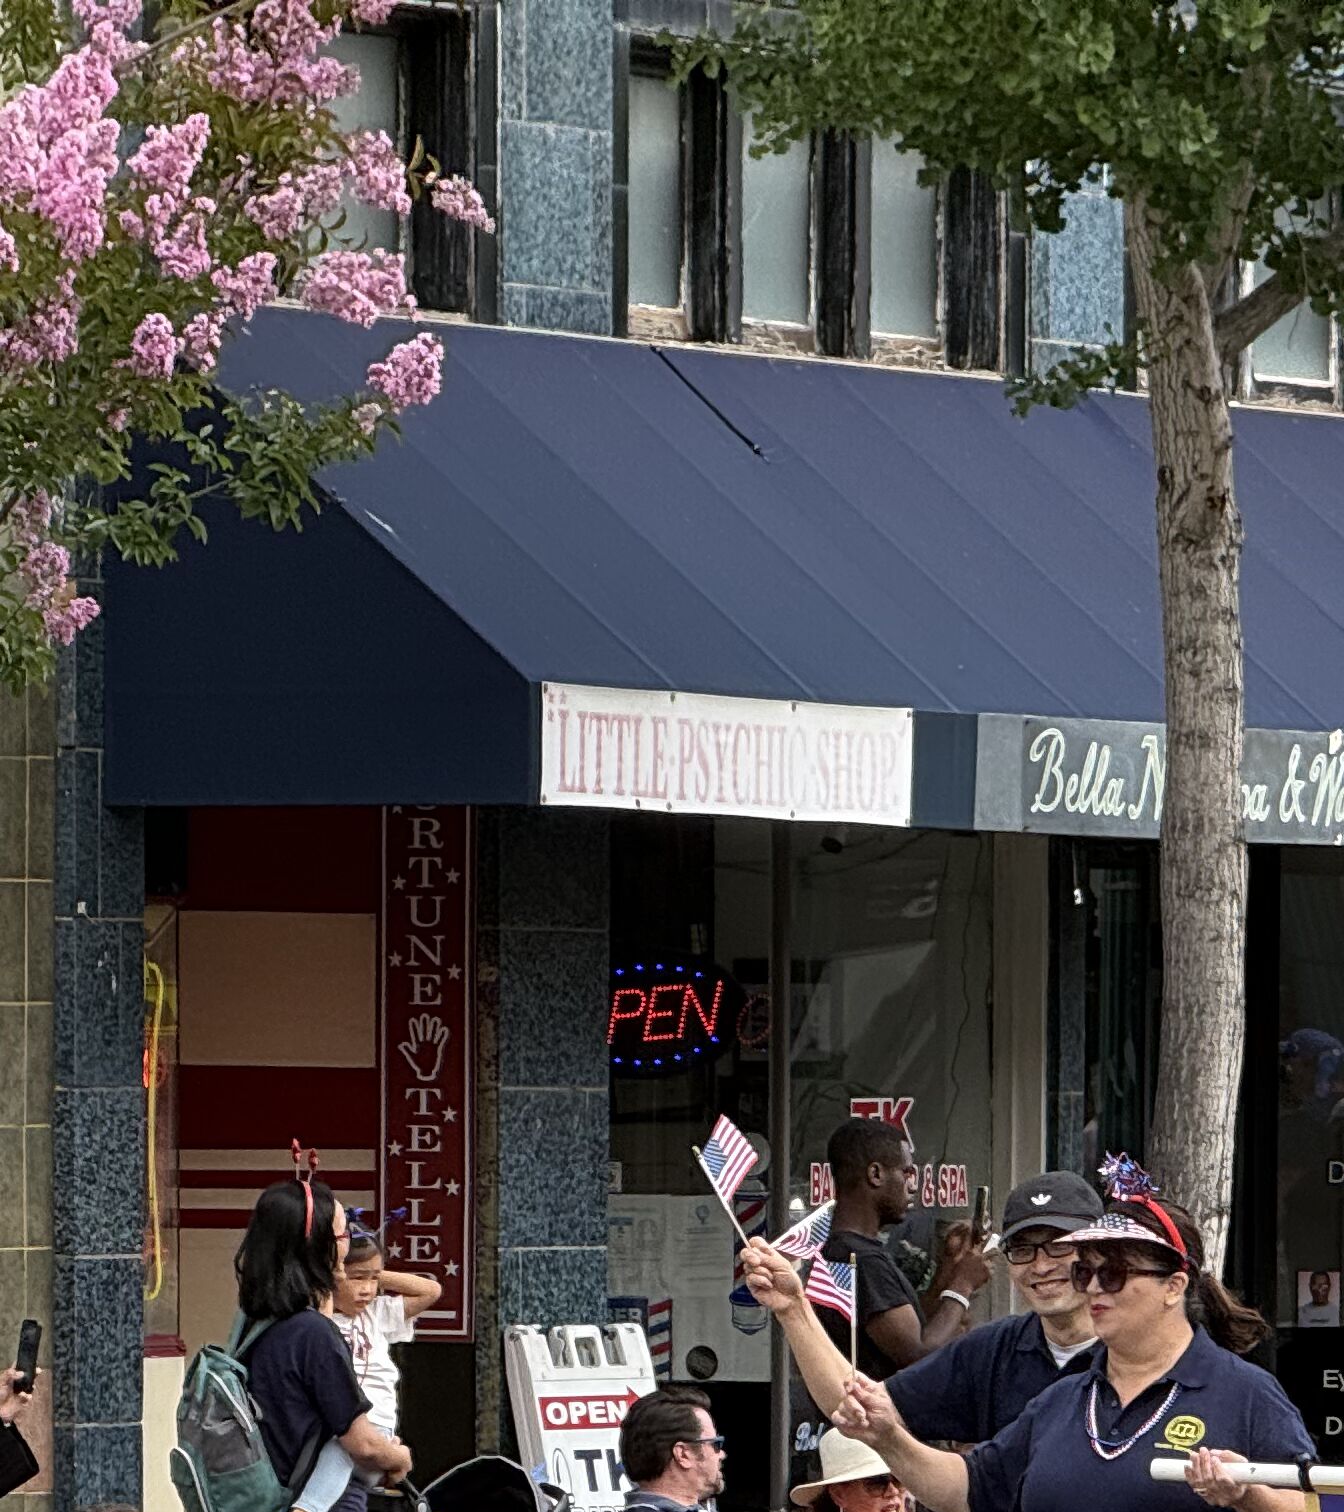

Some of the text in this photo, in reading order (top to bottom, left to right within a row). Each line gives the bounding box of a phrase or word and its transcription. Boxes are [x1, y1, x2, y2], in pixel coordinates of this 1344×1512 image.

[558, 709, 669, 798] LITTLE
[678, 718, 807, 804] PSYCHIC
[1029, 728, 1125, 817] Bella
[1279, 744, 1306, 824] &
[405, 805, 447, 1006] RTUNE
[607, 980, 724, 1045] PEN
[405, 1087, 441, 1281] TELLE
[938, 1164, 969, 1208] SPA
[546, 1400, 627, 1425] OPEN
